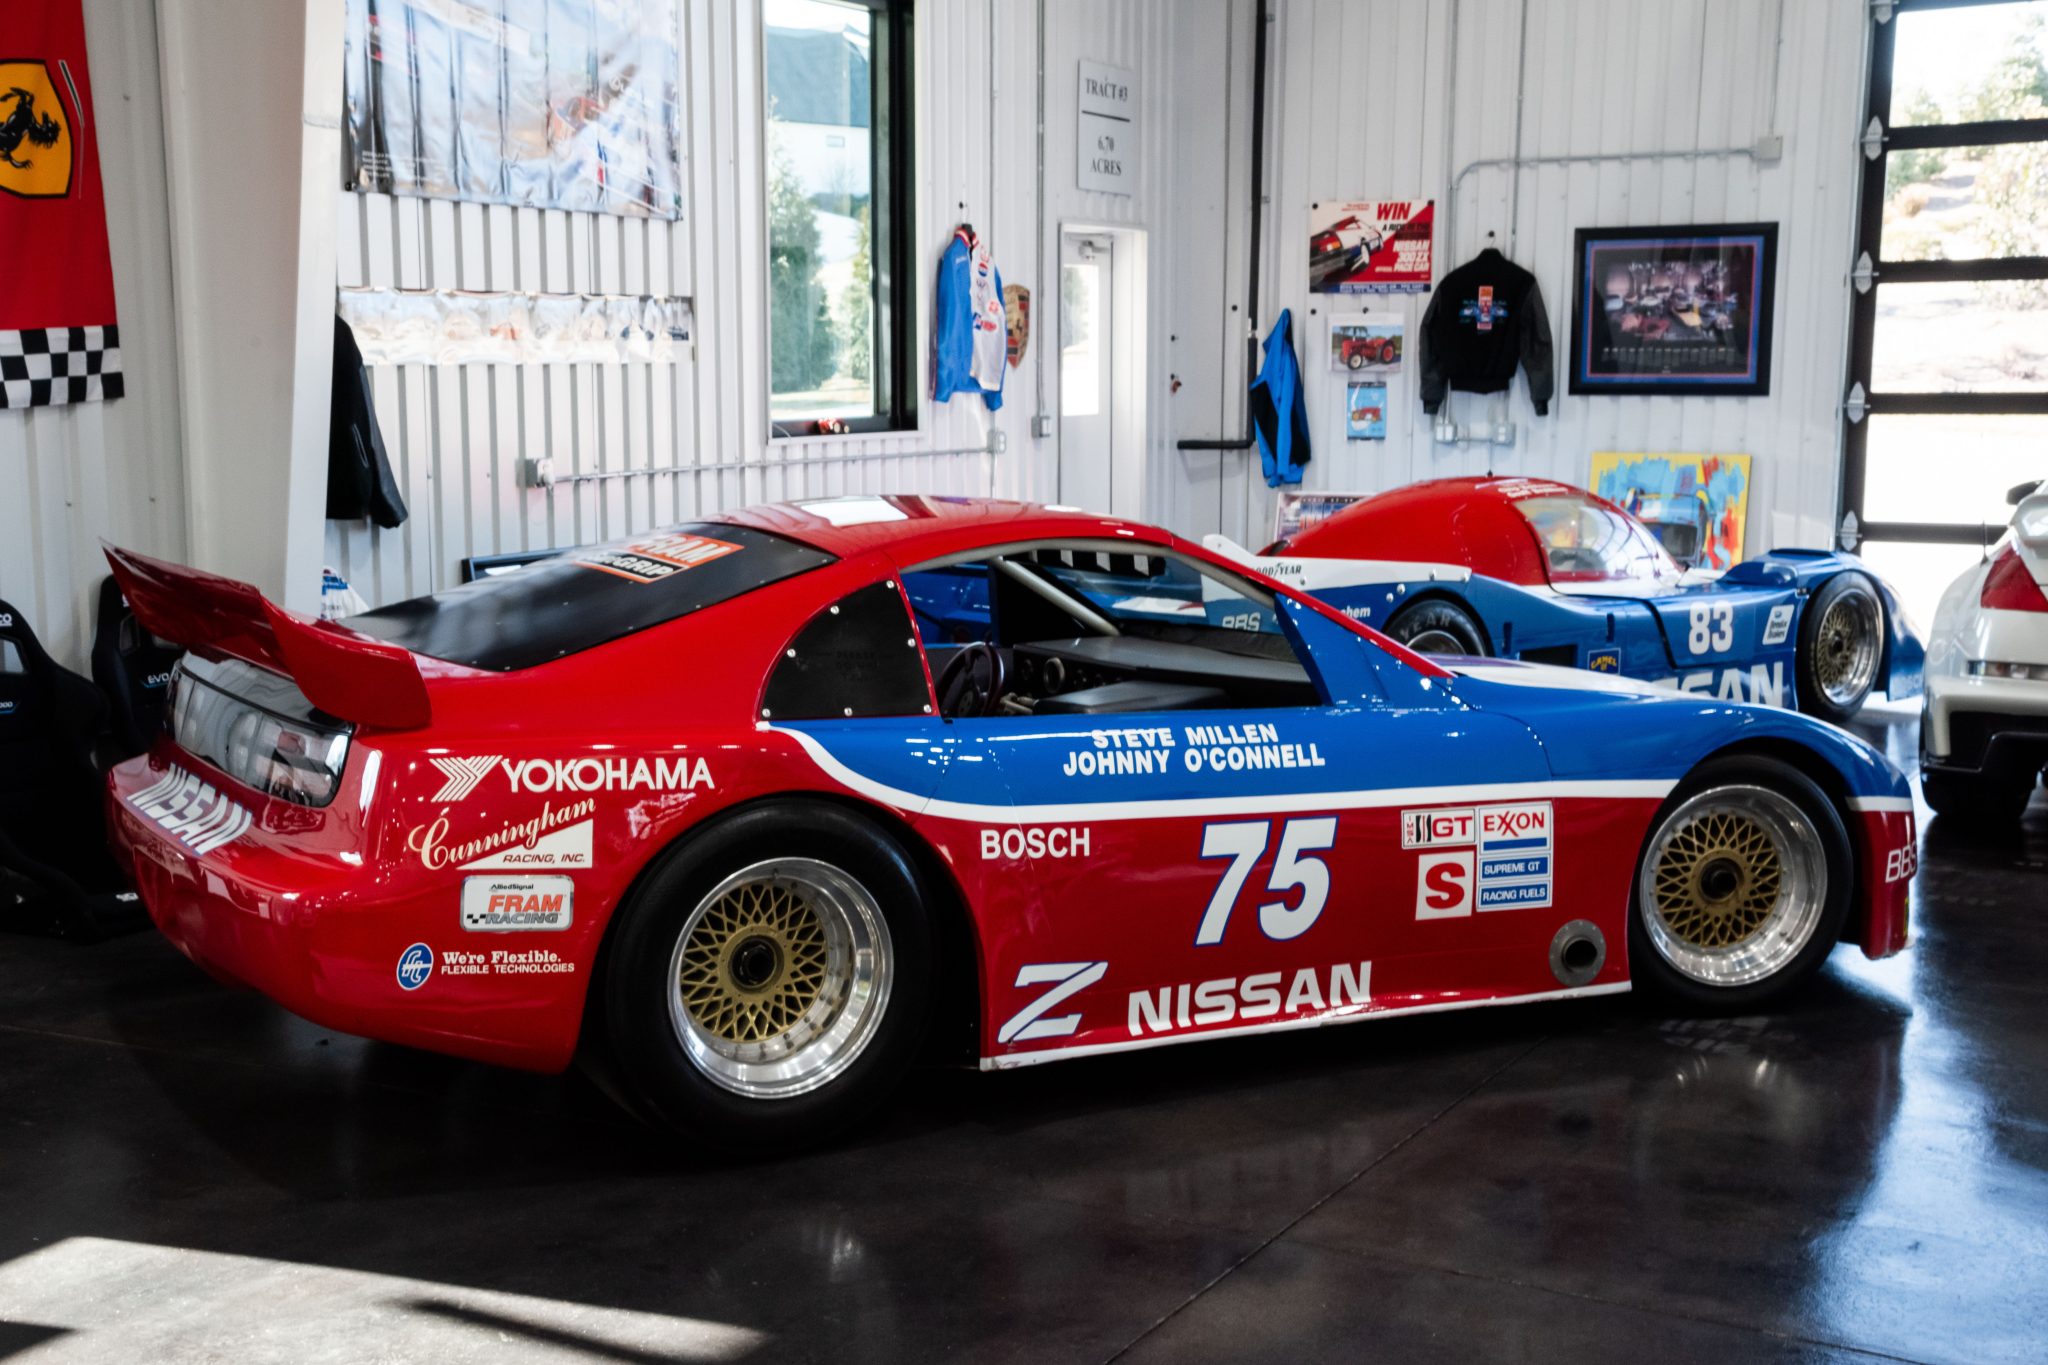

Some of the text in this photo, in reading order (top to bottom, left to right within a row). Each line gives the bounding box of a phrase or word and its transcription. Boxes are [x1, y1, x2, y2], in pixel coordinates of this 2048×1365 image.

[1085, 77, 1117, 100] TRACT
[1090, 158, 1122, 176] ACRES
[1377, 202, 1411, 221] WIN
[1688, 600, 1733, 655] 83
[1590, 655, 1617, 670] CAMEL
[1092, 723, 1279, 748] STEVE MILLEN
[1063, 743, 1326, 776] JOHNNY O'CONNELL
[501, 757, 715, 793] YOKOHAMA
[126, 761, 253, 856] NISSAN
[407, 798, 597, 870] Cunningham
[1432, 815, 1473, 838] GT
[1483, 810, 1545, 837] EXXON
[980, 827, 1090, 860] BOSCH
[503, 853, 586, 865] RACING, INC.
[1484, 861, 1540, 875] SUPREME GT
[1884, 841, 1917, 884] BBS
[1193, 815, 1339, 948] 75
[1425, 862, 1466, 910] S
[488, 894, 563, 913] FRAM
[1482, 888, 1546, 902] RACING FUELS
[485, 913, 559, 924] RACING
[441, 963, 575, 975] FLEXIBLE TECHNOLOGIES
[442, 950, 561, 964] We're Flexible.
[997, 961, 1109, 1043] Z
[1127, 960, 1372, 1037] NISSAN
